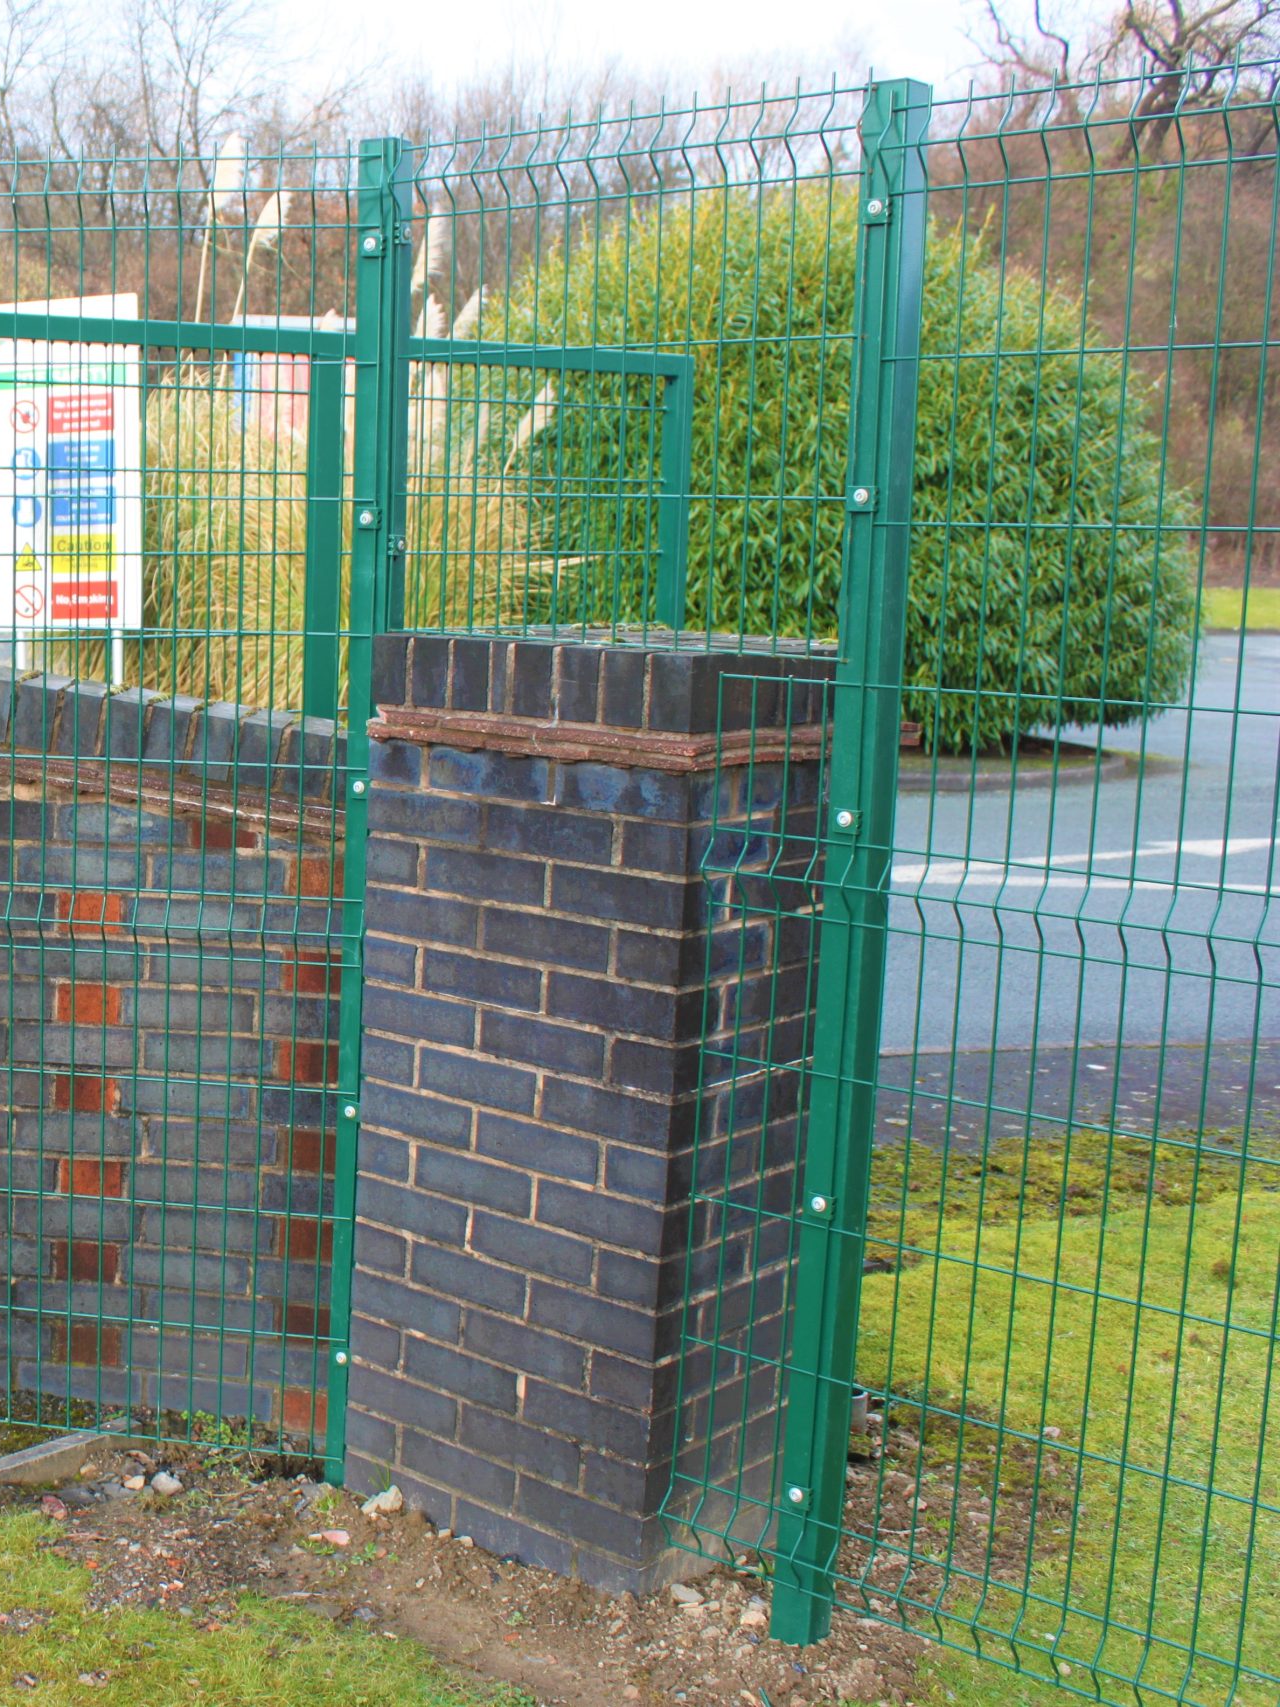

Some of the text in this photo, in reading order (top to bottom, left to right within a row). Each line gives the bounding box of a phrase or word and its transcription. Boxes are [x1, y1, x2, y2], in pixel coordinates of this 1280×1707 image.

[57, 539, 110, 552] Caution
[55, 593, 114, 606] No Smoking
